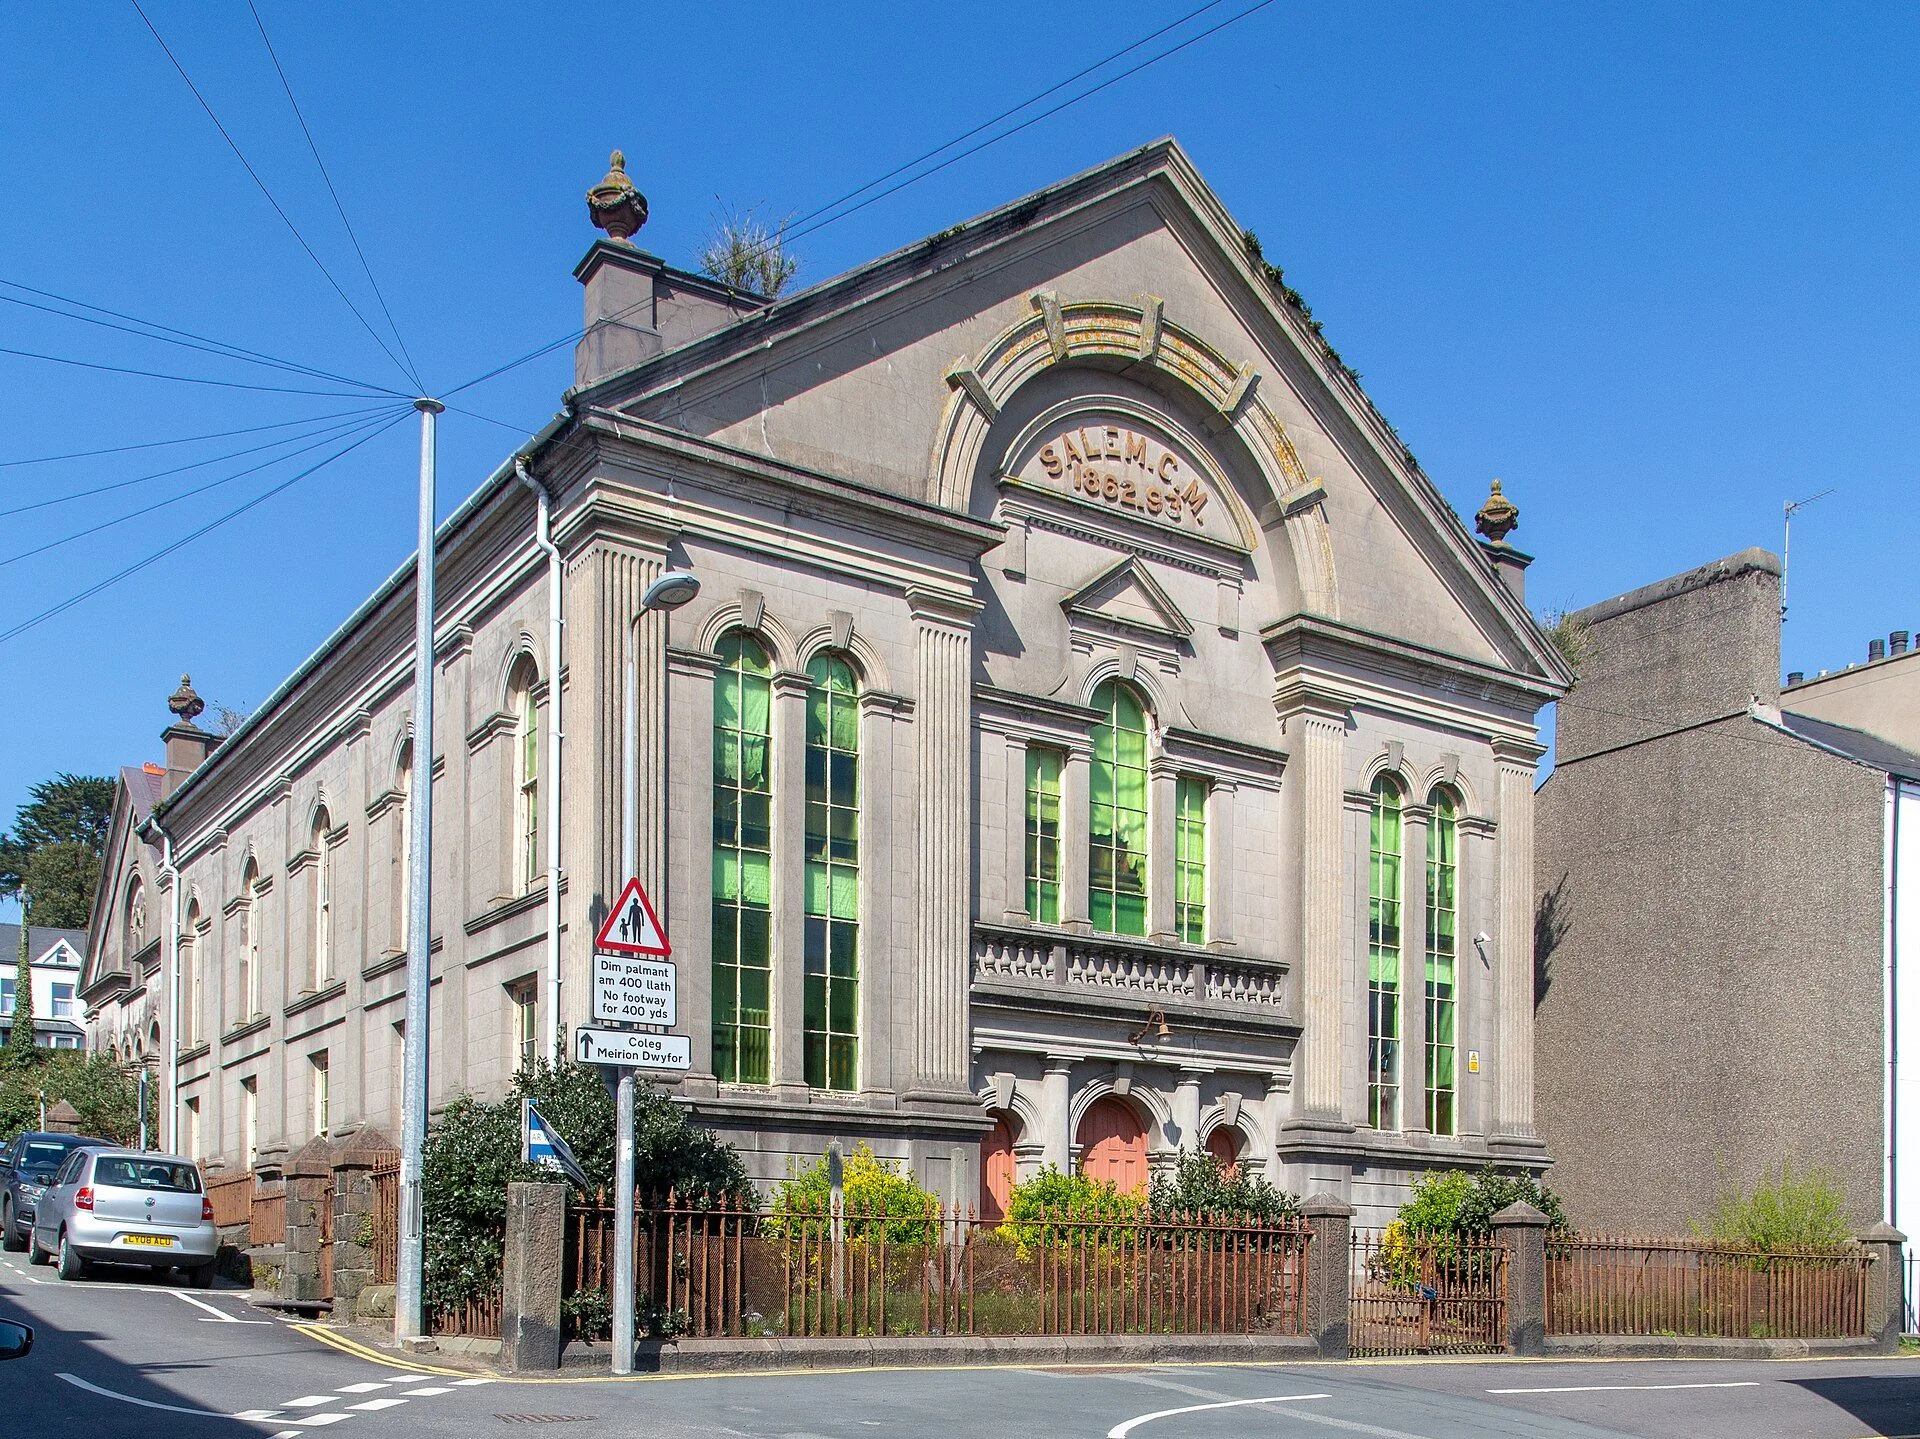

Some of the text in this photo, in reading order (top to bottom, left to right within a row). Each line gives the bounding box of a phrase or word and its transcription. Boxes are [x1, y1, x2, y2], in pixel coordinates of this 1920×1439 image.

[601, 960, 669, 978] Dim palmant
[599, 976, 671, 991] am 400 llath
[603, 990, 666, 1007] No footway
[602, 1003, 668, 1019] for 400 yds
[629, 1037, 662, 1050] Coleg
[597, 1047, 683, 1063] Meirion Dwyfor
